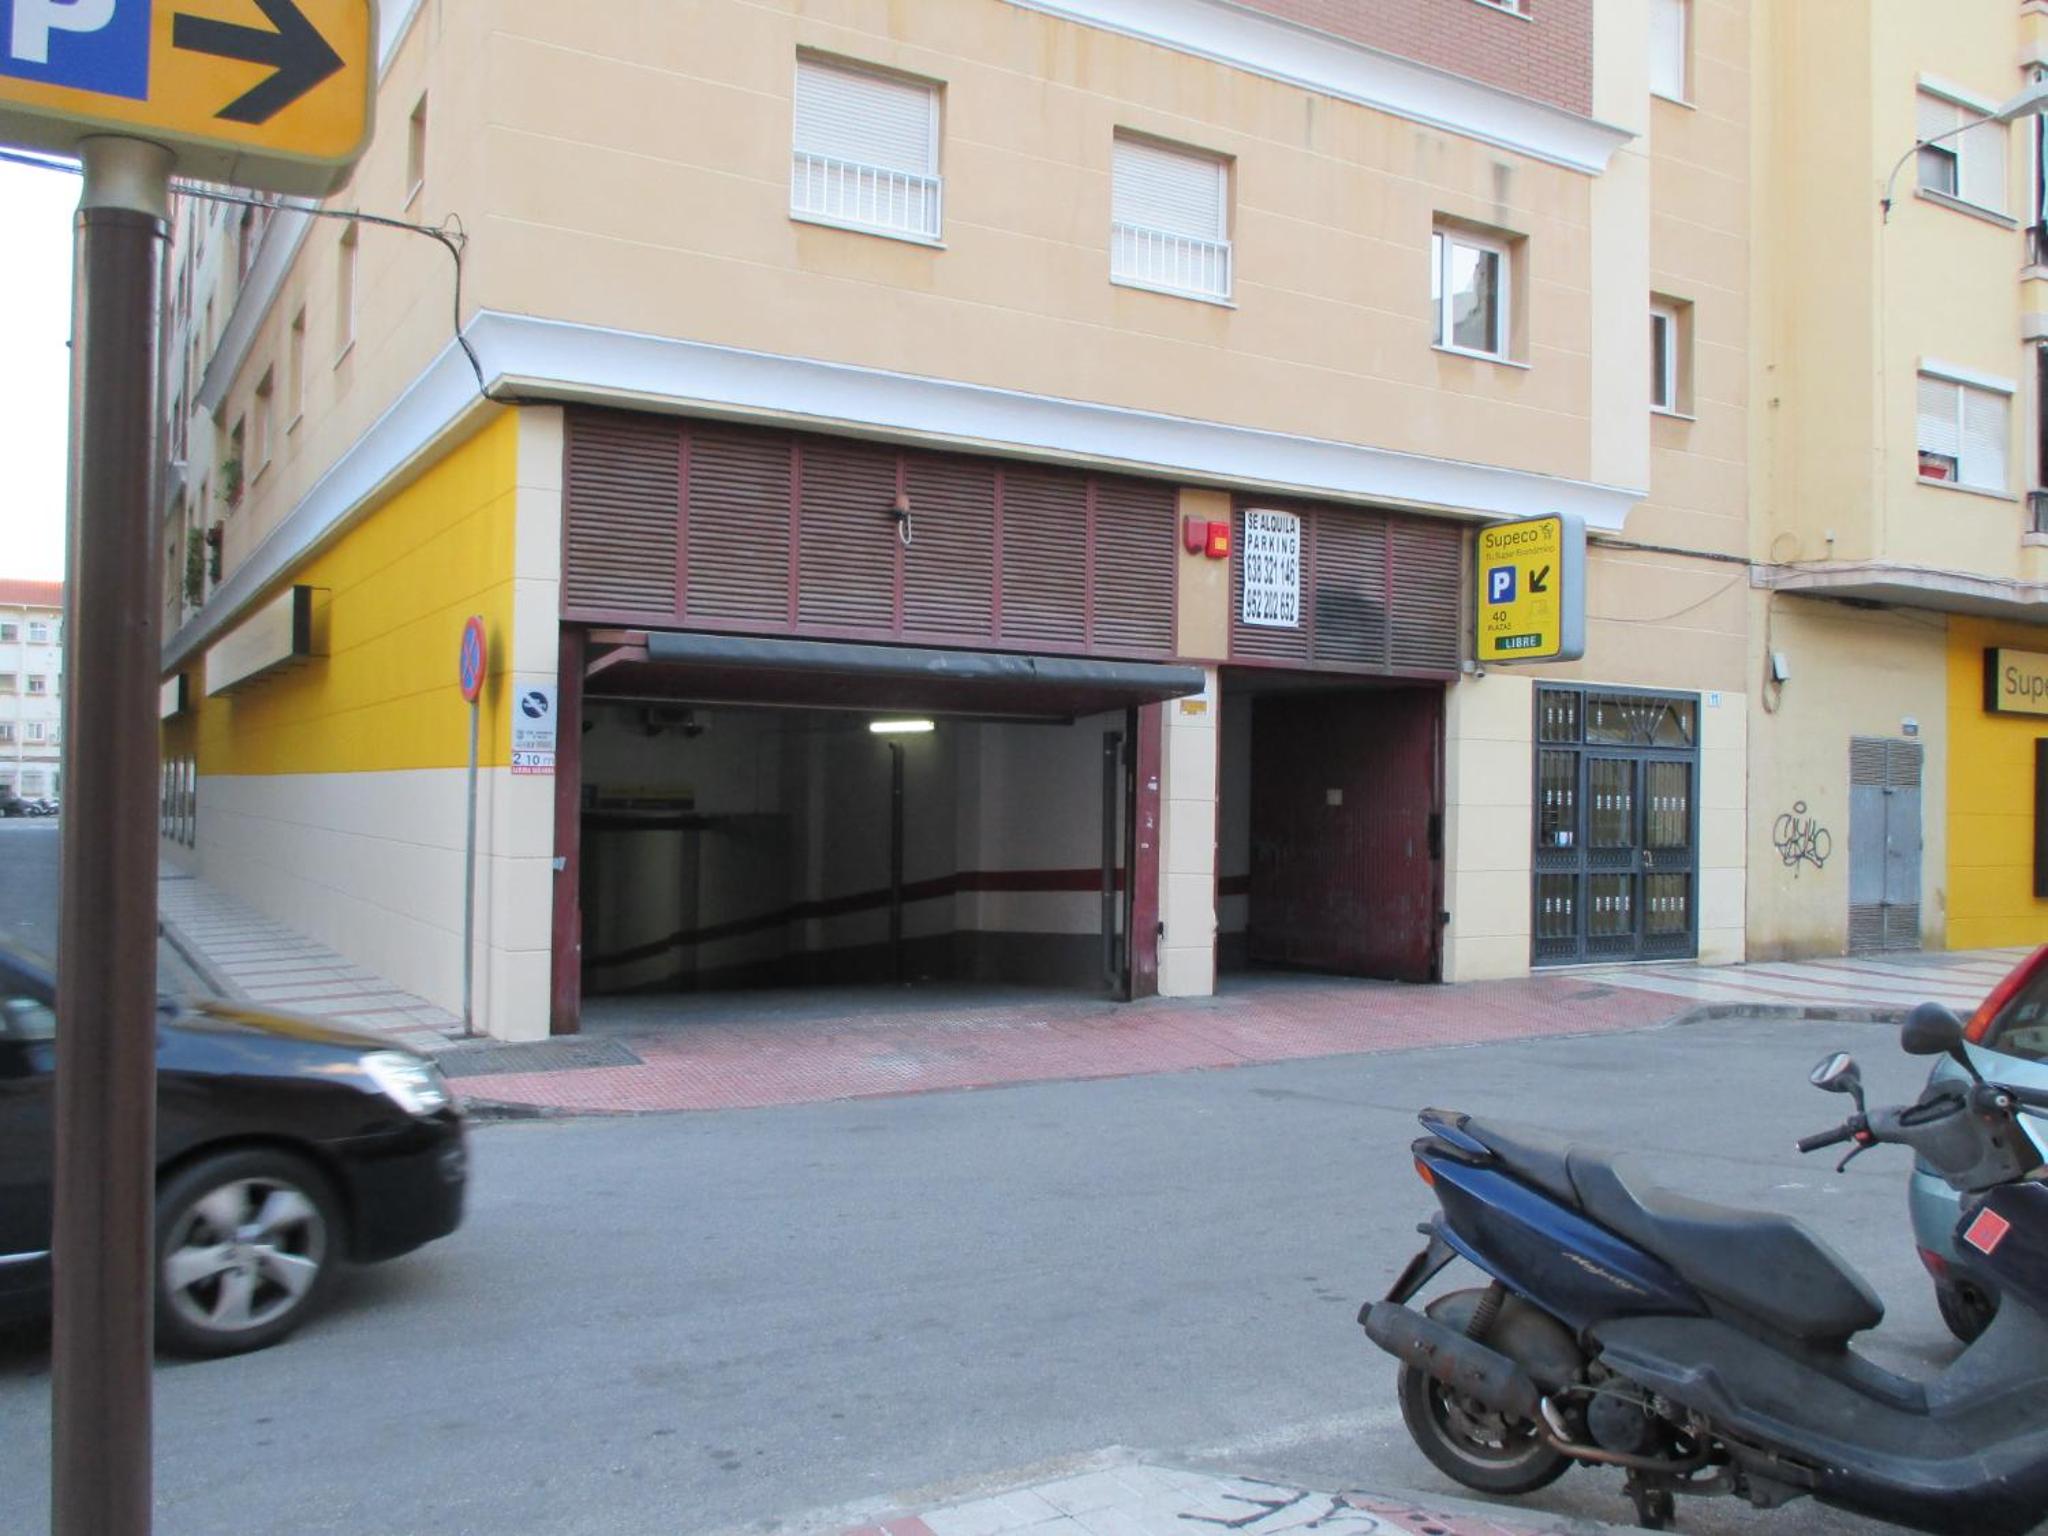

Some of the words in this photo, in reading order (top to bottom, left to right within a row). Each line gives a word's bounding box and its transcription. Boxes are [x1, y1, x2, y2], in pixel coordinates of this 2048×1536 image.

[11, 0, 116, 64] P
[1247, 512, 1259, 530] SE
[1260, 514, 1296, 534] ALQUILA
[1247, 533, 1295, 555] PARKING
[1486, 530, 1538, 549] Supeco
[1264, 555, 1278, 585] 321
[1280, 556, 1296, 587] 146
[1493, 572, 1511, 600] P
[1246, 588, 1262, 618] 952
[1263, 589, 1279, 619] 202
[1280, 591, 1295, 622] 652
[1492, 610, 1507, 622] 40
[1505, 636, 1537, 649] LIBRE
[2005, 666, 2048, 704] Sup
